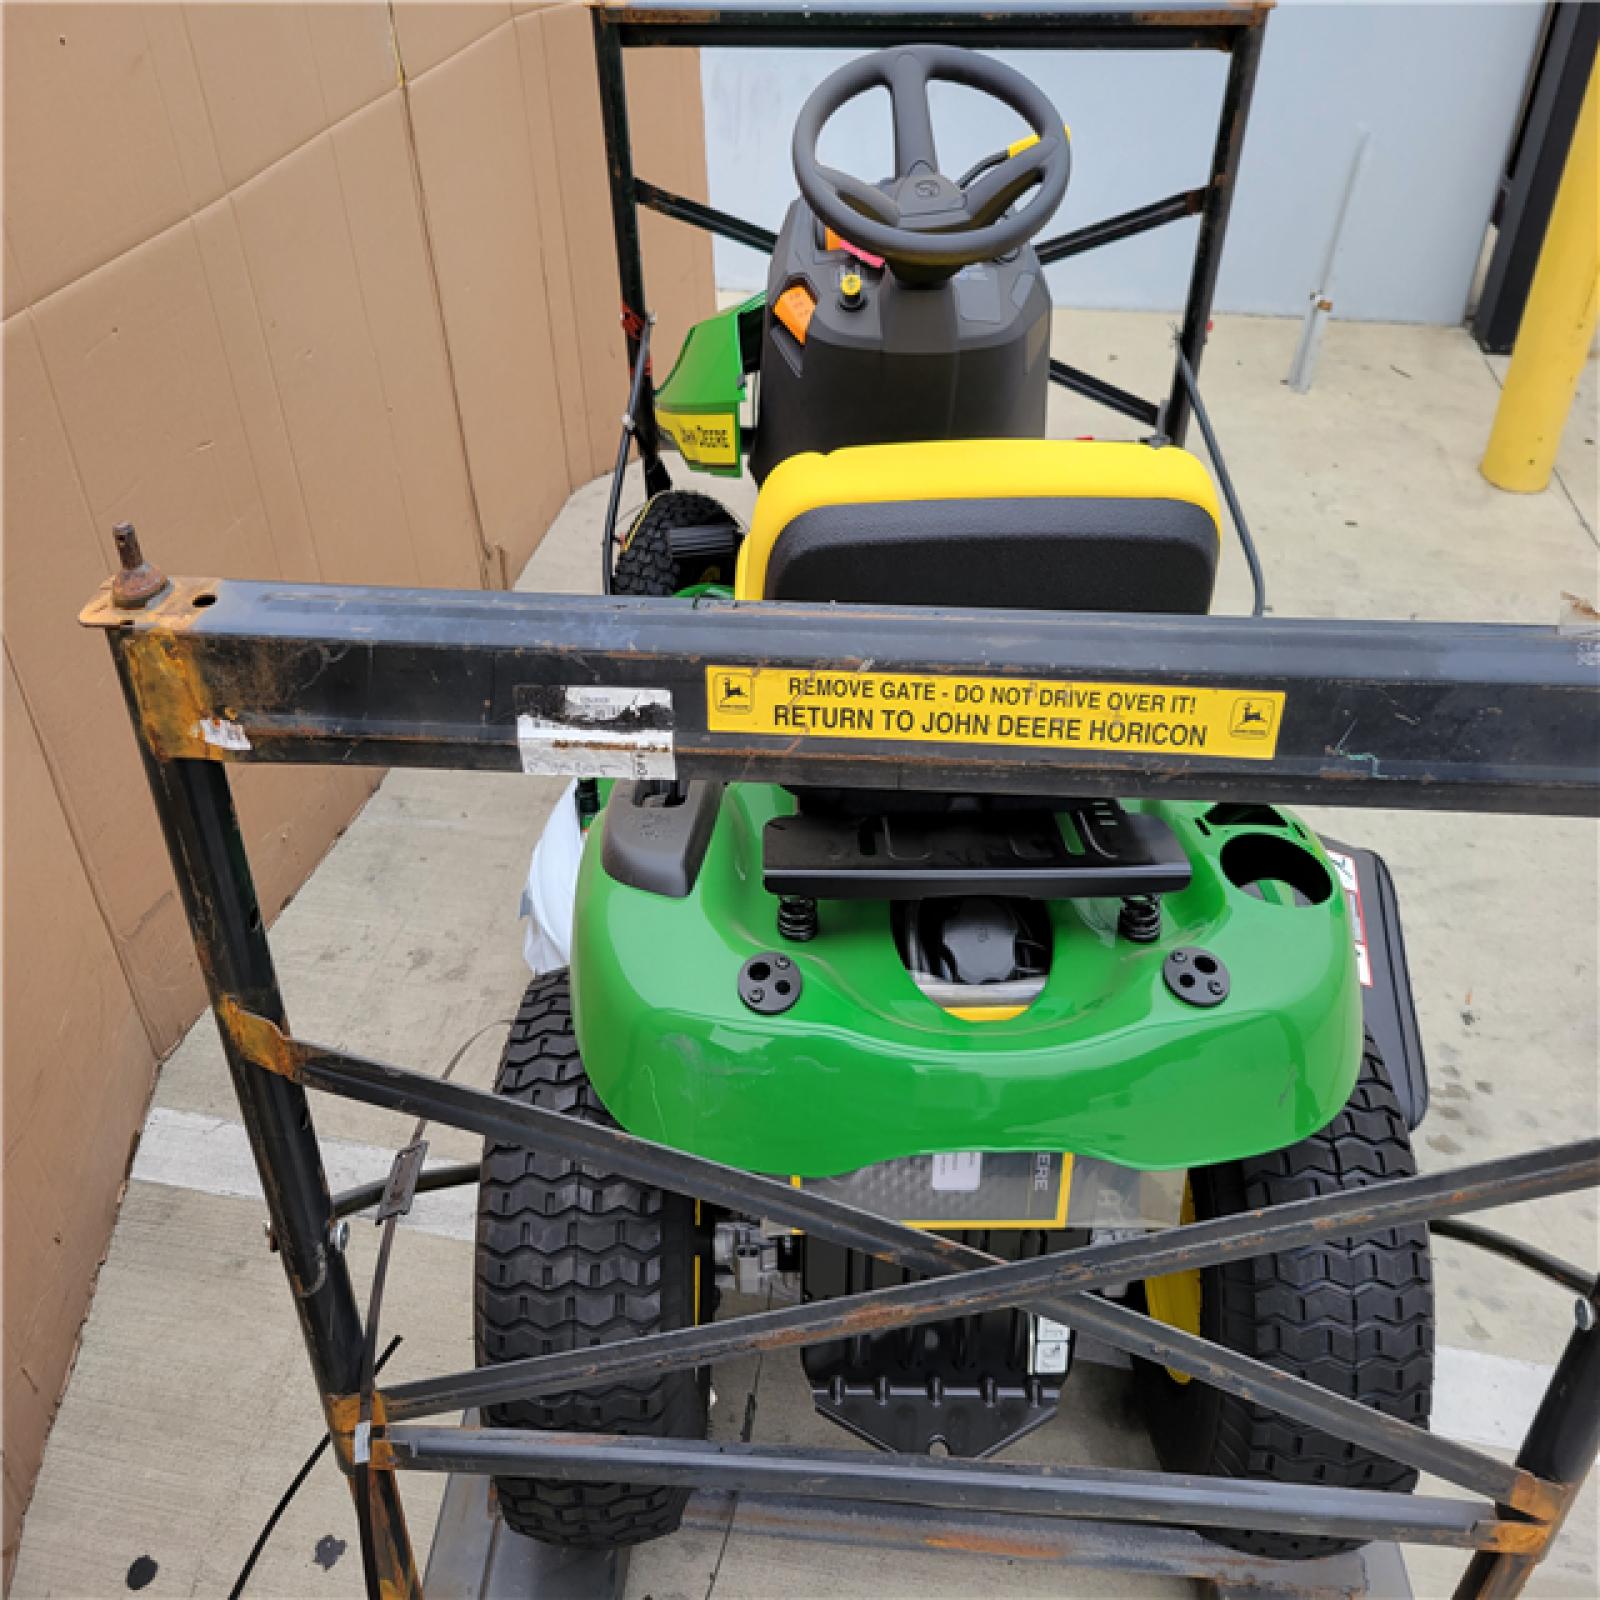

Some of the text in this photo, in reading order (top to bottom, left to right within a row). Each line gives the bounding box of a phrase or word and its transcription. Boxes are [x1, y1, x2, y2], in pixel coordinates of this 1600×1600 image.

[789, 678, 873, 698] REMOVE
[880, 682, 935, 700] GATE
[955, 685, 984, 703] DO
[990, 687, 1032, 706] NOT
[1040, 690, 1100, 709] DRIVE
[1108, 693, 1165, 712] OVER
[1170, 695, 1196, 714] IT!
[775, 705, 1207, 746] RETURN TO JOHN DEERE HORICON
